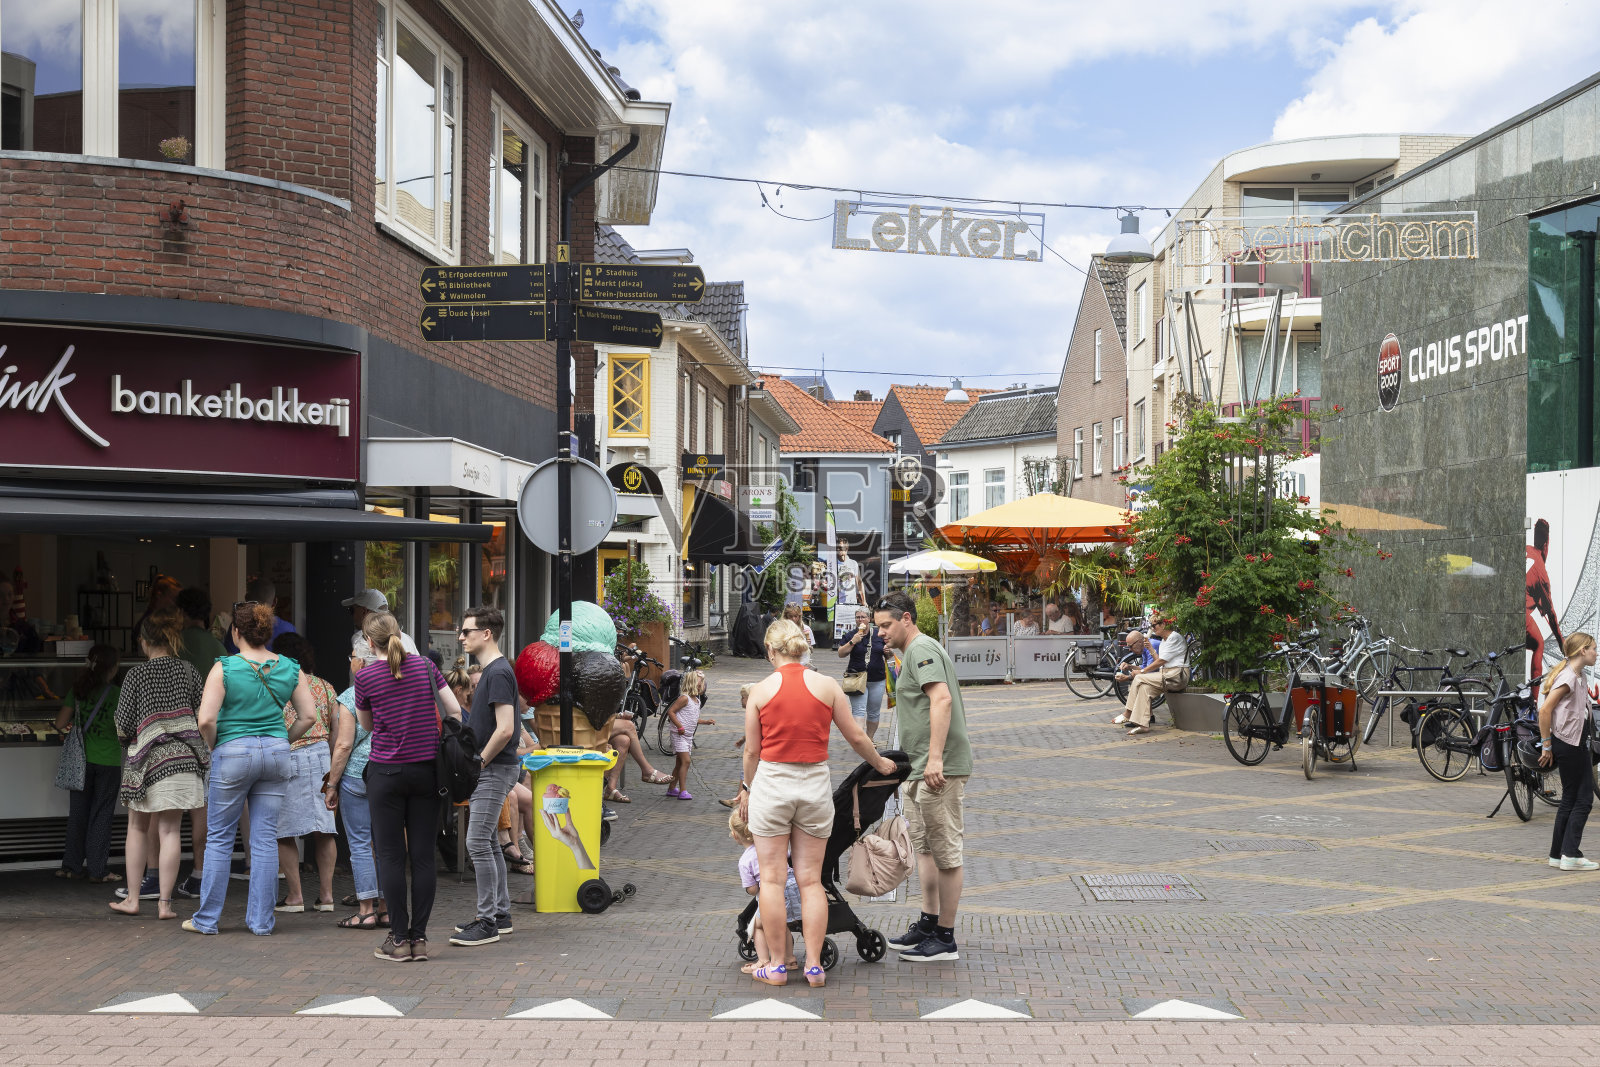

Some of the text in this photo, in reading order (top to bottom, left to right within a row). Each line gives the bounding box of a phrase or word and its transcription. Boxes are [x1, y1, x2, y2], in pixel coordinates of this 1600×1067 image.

[1183, 213, 1477, 267] Doetinchem
[448, 271, 508, 279] Erfgoedcentrum
[605, 269, 638, 277] Stadhuis
[449, 281, 492, 289] Bibliotheek
[449, 292, 486, 300] Walmolen
[449, 308, 468, 317] Oude
[1408, 314, 1528, 383] CLAUS SPORT
[1379, 355, 1400, 373] SPORT
[1380, 373, 1398, 389] 2000
[0, 344, 110, 447] ink
[111, 374, 350, 437] banketbakkerij
[985, 649, 1001, 666] ijs
